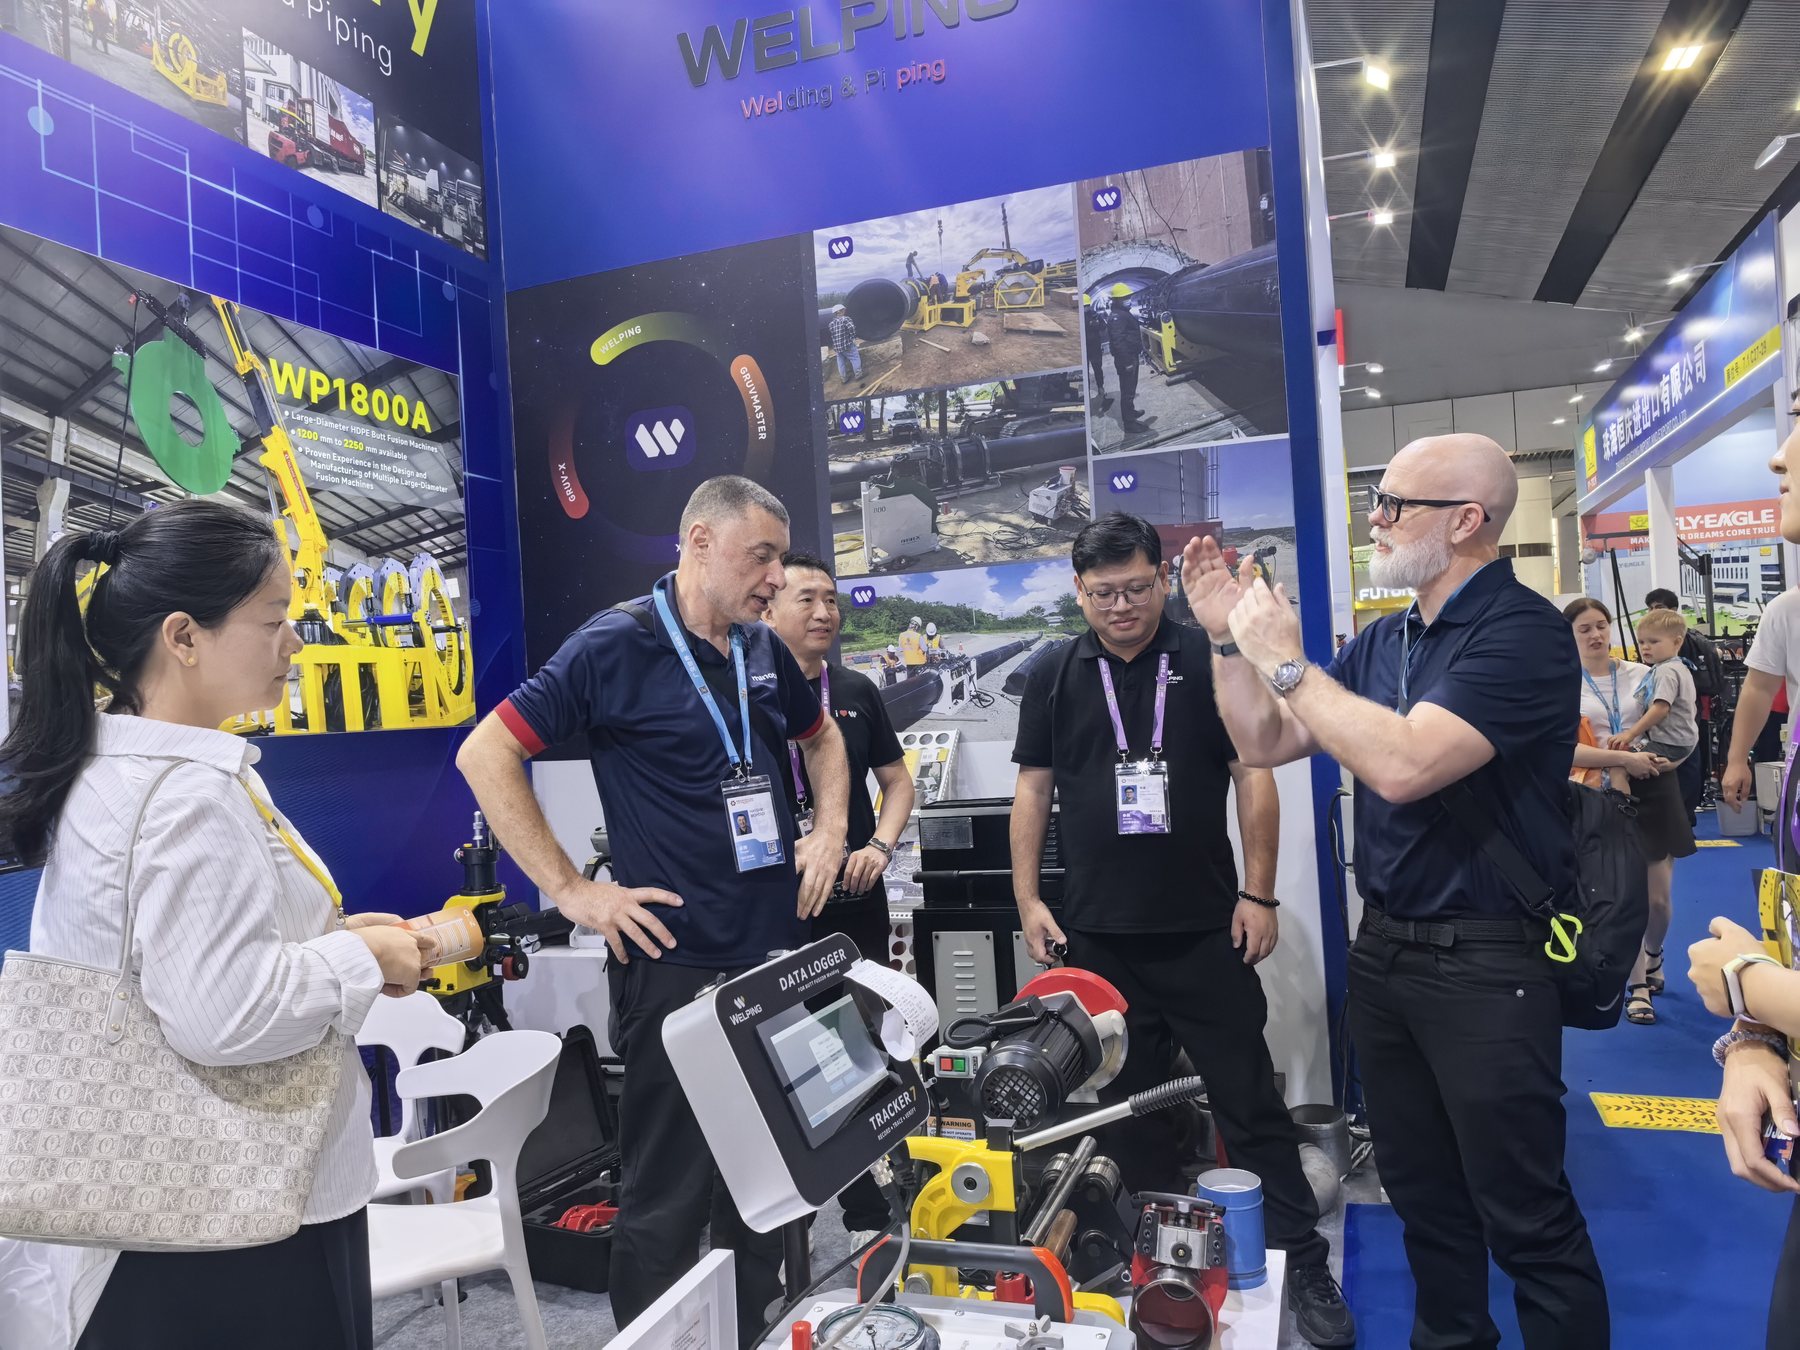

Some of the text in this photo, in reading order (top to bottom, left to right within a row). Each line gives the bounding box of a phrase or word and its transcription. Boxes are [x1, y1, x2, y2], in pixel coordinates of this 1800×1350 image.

[307, 0, 392, 76] Piping
[741, 83, 833, 119] Welding
[841, 75, 858, 97] &
[600, 325, 642, 354] WELPING
[268, 358, 432, 433] WP1800A
[740, 367, 767, 440] GRUVMASTER
[291, 411, 438, 453] Large-Diameter HDPE Butt Fusion Machines
[297, 428, 319, 441] 1200
[320, 435, 333, 444] mm
[334, 438, 342, 446] to
[343, 438, 364, 451] 2250
[379, 449, 408, 460] available
[305, 447, 427, 479] Proven Experience in the Design and
[310, 460, 363, 478] Manufacturing
[372, 472, 399, 484] Multiple
[400, 478, 448, 493] Large-Diameter
[315, 472, 374, 489] Fusion Machines
[558, 463, 577, 502] GRUV-X
[1688, 530, 1724, 541] DREAMS
[1726, 528, 1751, 537] COME
[1752, 526, 1776, 535] TRUE
[779, 948, 847, 991] DATA LOGGER
[729, 1003, 763, 1026] WELPING
[868, 1085, 917, 1130] TRACKER 7
